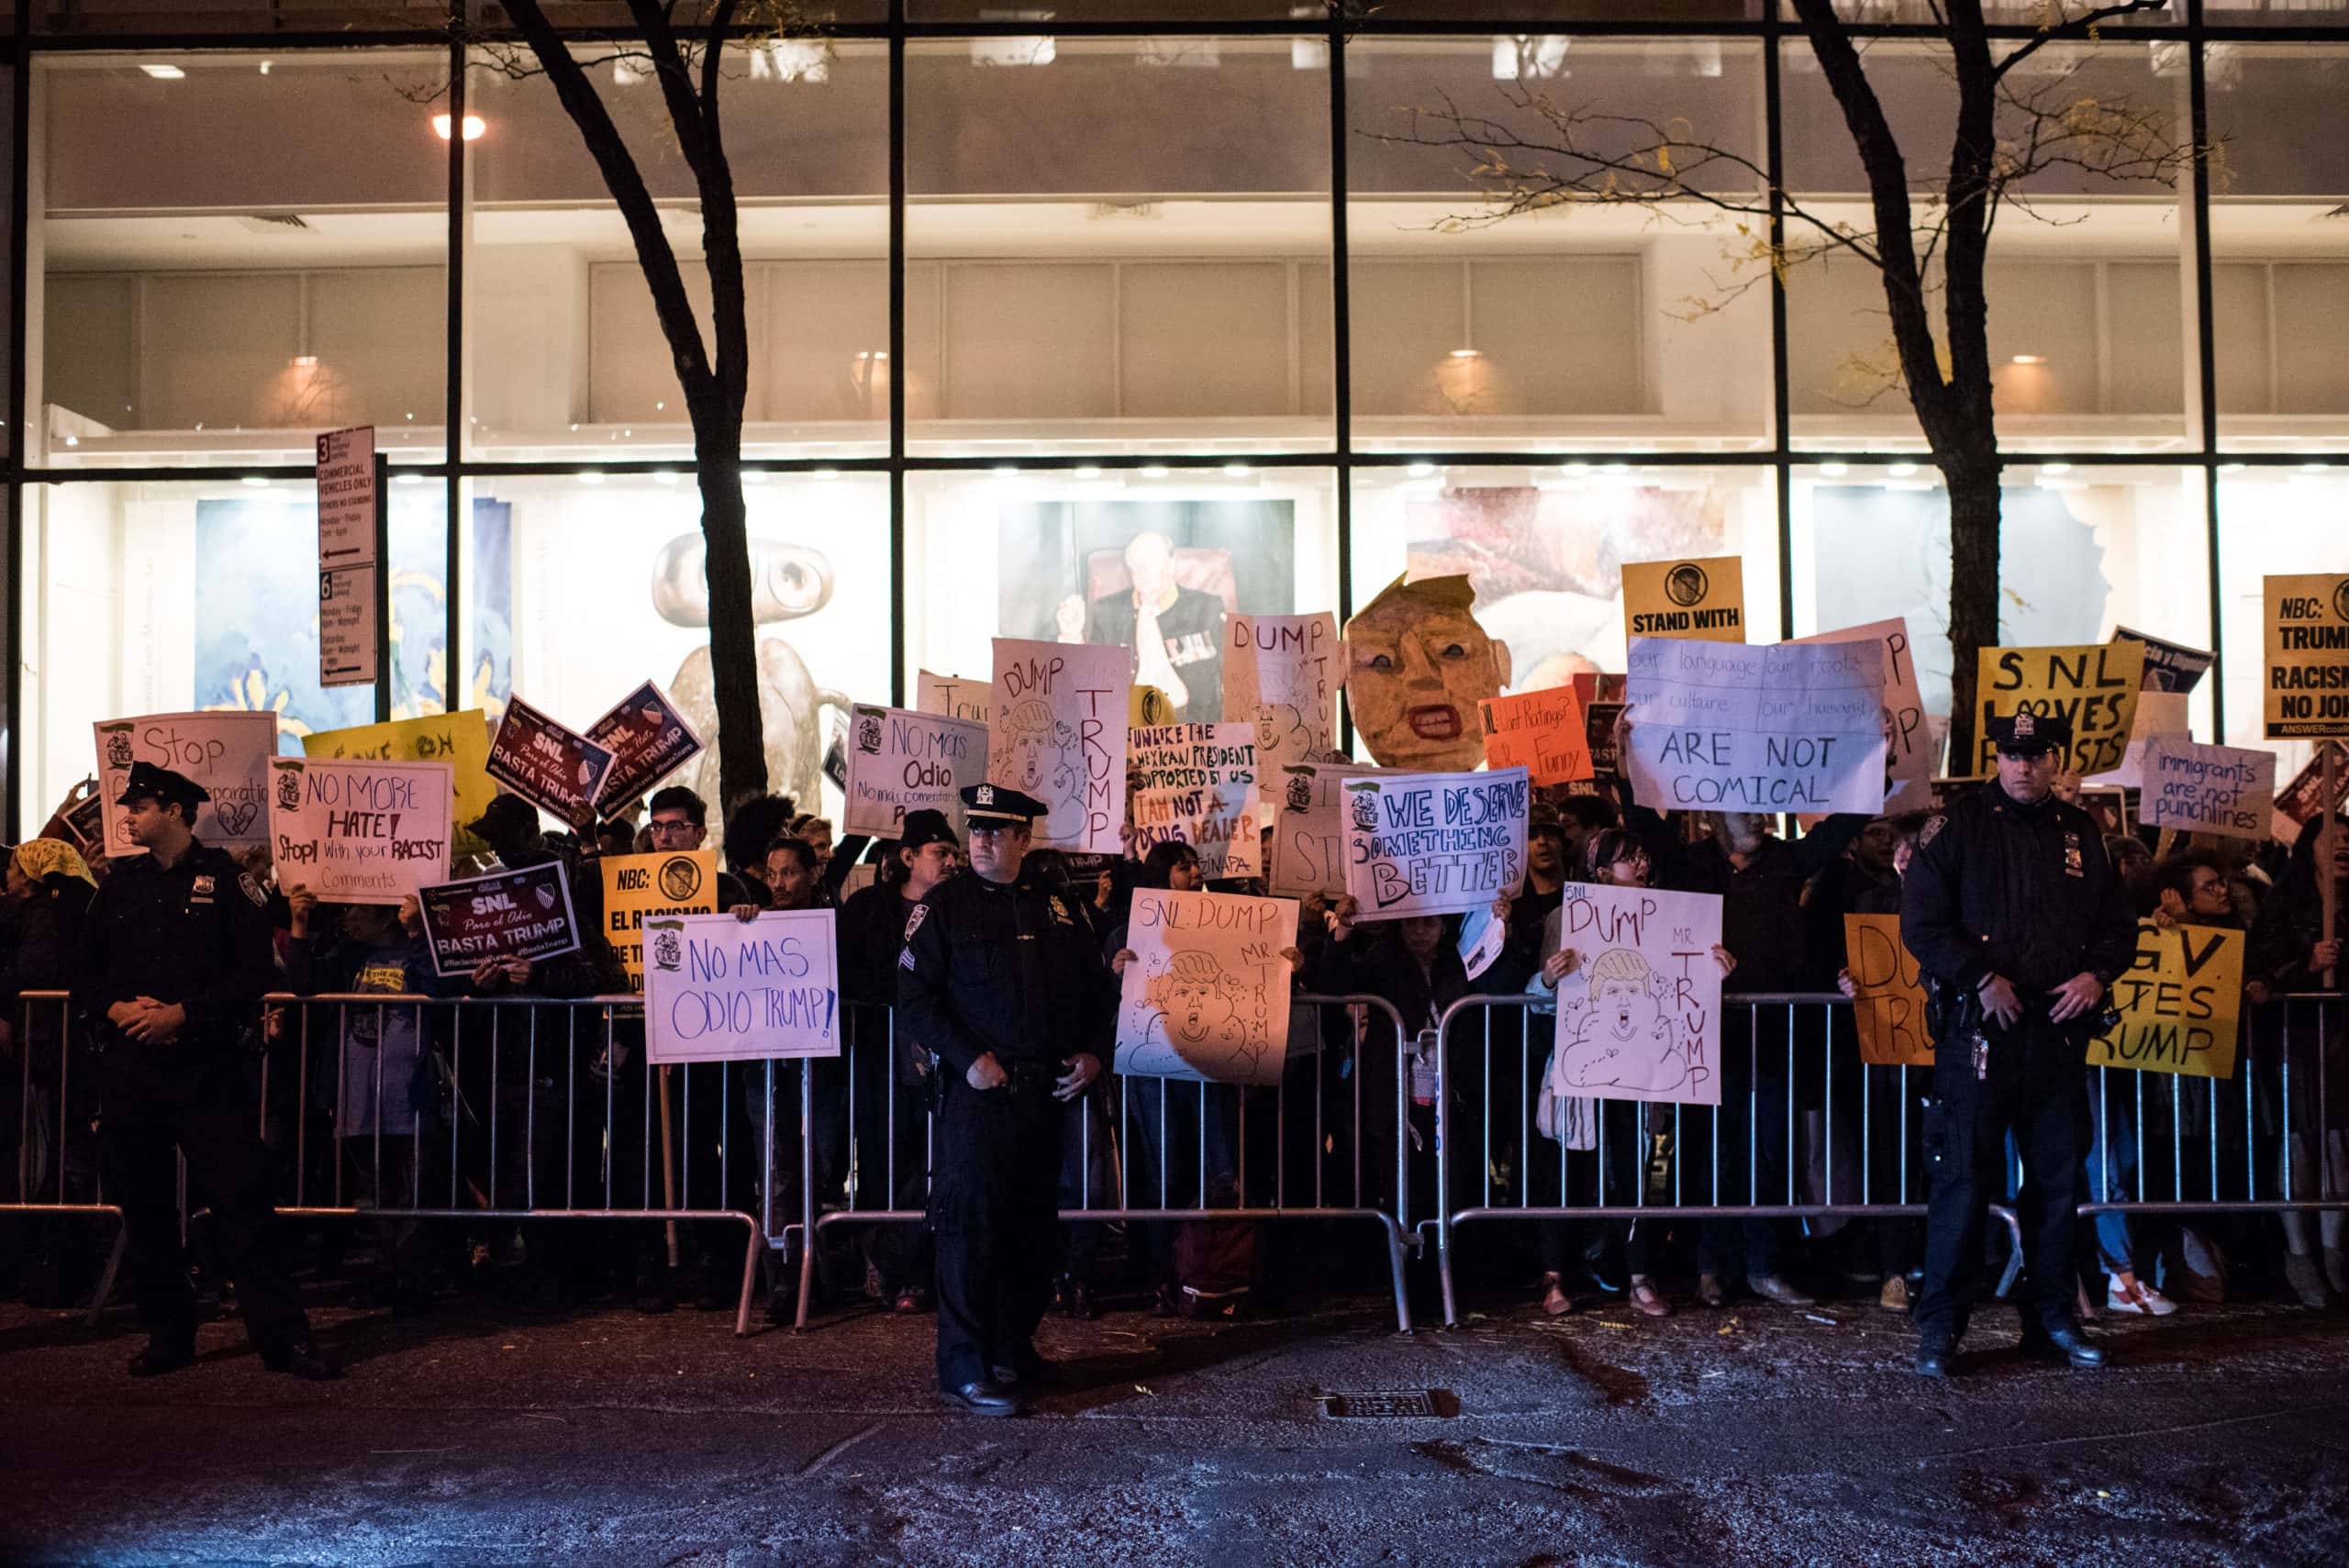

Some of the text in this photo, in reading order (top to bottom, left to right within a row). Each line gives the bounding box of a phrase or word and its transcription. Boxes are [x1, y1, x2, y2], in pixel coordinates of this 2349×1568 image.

[319, 438, 328, 462] 3
[319, 462, 364, 481] COMMERCIAL
[320, 476, 372, 495] VEHICLES ONLY
[321, 574, 330, 598] 6
[1632, 607, 1740, 633] STAND WITH
[2279, 597, 2324, 619] NBC:
[1234, 621, 1323, 654] DUMP
[2278, 626, 2349, 650] TRUM
[1003, 657, 1064, 697] DUMP
[1629, 644, 1757, 680] our language
[1767, 659, 1794, 675] our
[1523, 696, 1571, 729] Ratings?
[1669, 691, 1731, 712] culture
[1762, 701, 1793, 717] our
[2281, 695, 2313, 719] NO
[144, 727, 225, 775] Stop
[532, 731, 564, 762] SNL
[635, 726, 683, 767] TRUMP
[1133, 723, 1215, 749] UNLIKE THE
[1658, 731, 1836, 768] ARE NOT
[493, 744, 535, 782] BASTA
[1075, 689, 1113, 849] TRUMP
[1137, 745, 1254, 768] MEXICAN PRESIDENT
[1534, 734, 1580, 779] Funny
[2158, 754, 2257, 784] immigrants
[903, 760, 952, 789] Odio
[1144, 768, 1208, 789] UPPORTED
[1230, 770, 1254, 784] US
[1568, 782, 1600, 795] SNL
[1673, 774, 1831, 805] COMICAL
[206, 778, 269, 812] eparatio
[306, 771, 419, 811] NO MORE
[1384, 780, 1528, 828] WE DESERVE
[2163, 782, 2244, 807] are not
[1136, 790, 1230, 825] I AM NOT A
[2155, 795, 2258, 830] punchlines
[327, 810, 402, 840] HATE!
[1138, 815, 1256, 851] DRUG DEALER
[355, 844, 387, 866] your
[391, 839, 444, 862] RACIST
[1353, 826, 1511, 864] SOMETHING
[321, 866, 398, 890] Comments
[616, 867, 651, 892] NBC:
[1372, 848, 1520, 908] BETTER
[471, 893, 518, 916] SNL
[611, 910, 629, 931] EL
[1197, 898, 1278, 935] DUMP
[438, 917, 566, 955] BASTA TRUMP
[1569, 897, 1657, 947] DUMP
[689, 938, 727, 983] NO
[740, 937, 809, 978] MAS
[672, 986, 836, 1040] ODIO TRUMP!
[1253, 962, 1275, 1065] TRUMP
[2121, 979, 2215, 1020] TES
[1671, 951, 1710, 1097] TRUMP
